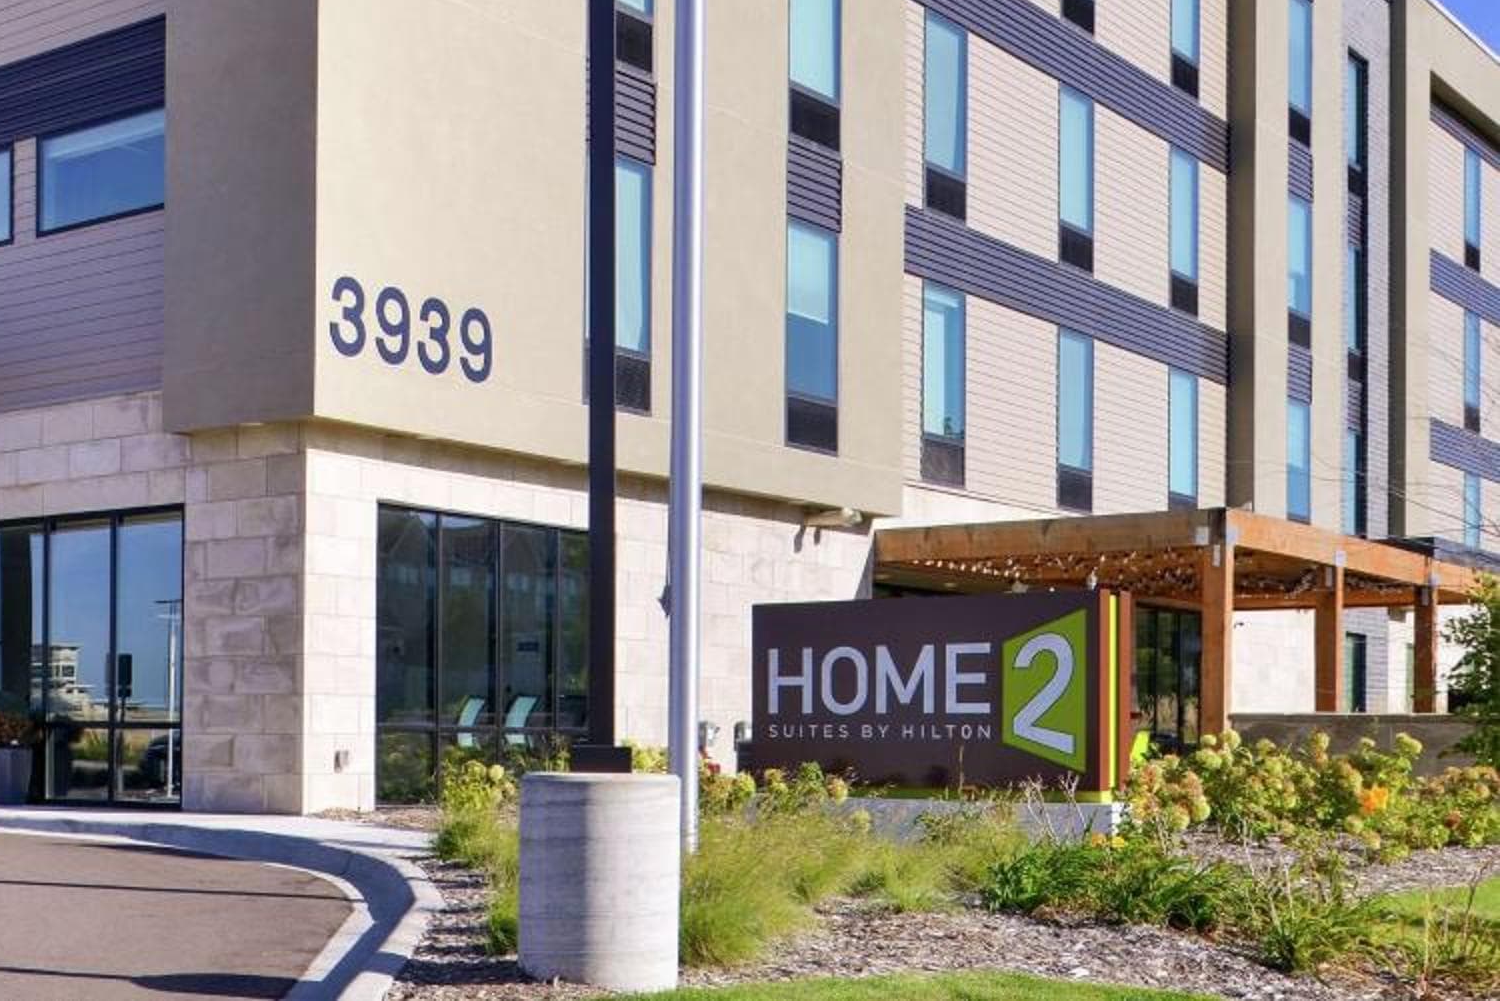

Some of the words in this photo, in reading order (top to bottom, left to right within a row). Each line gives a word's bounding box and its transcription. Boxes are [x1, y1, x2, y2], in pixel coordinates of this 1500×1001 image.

[329, 276, 492, 383] 3939
[768, 642, 991, 715] HOME
[1013, 632, 1075, 754] 2
[768, 724, 848, 739] SUITES
[861, 724, 889, 739] BY
[902, 724, 992, 739] HILTON
